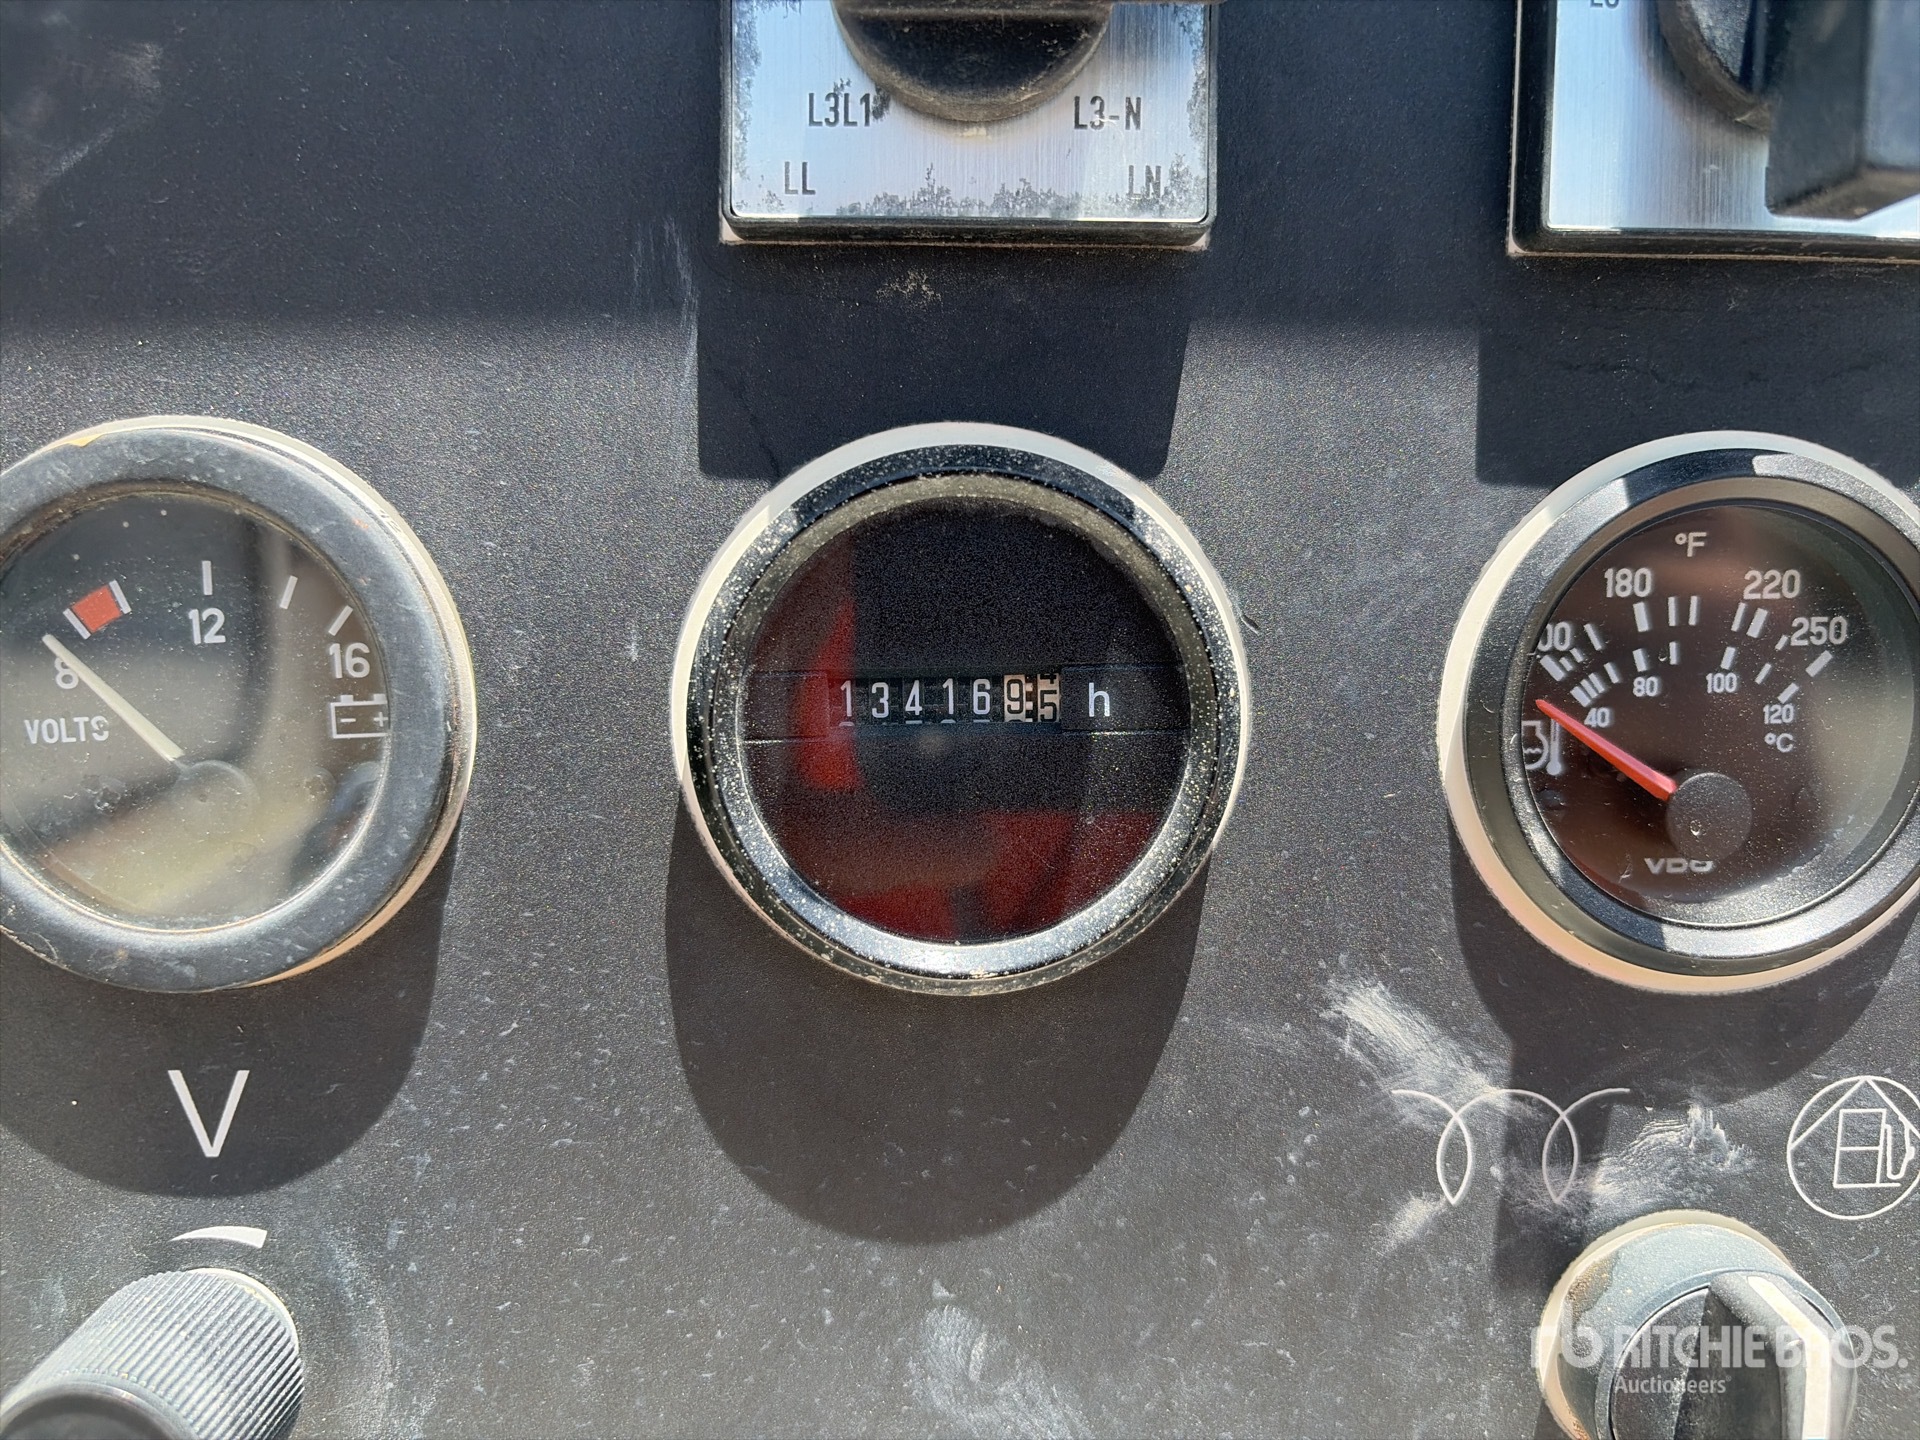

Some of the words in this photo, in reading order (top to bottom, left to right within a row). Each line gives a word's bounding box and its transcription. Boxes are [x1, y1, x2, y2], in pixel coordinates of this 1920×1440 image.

[808, 92, 871, 127] L3L1
[1074, 96, 1142, 130] L3-N
[784, 161, 816, 196] LL
[1127, 164, 1162, 199] LN
[1604, 568, 1653, 598] 180
[1744, 570, 1801, 600] 220
[188, 608, 227, 646] 12
[1791, 616, 1848, 647] 250
[54, 657, 80, 690] 8
[328, 641, 371, 679] 16
[1633, 676, 1659, 697] 80
[1706, 673, 1738, 694] 100
[1088, 682, 1111, 718] h
[1763, 704, 1795, 724] 120
[24, 715, 110, 744] VOLTS
[1584, 707, 1611, 728] 40
[1643, 857, 1714, 875] VDO
[168, 1069, 250, 1158] V
